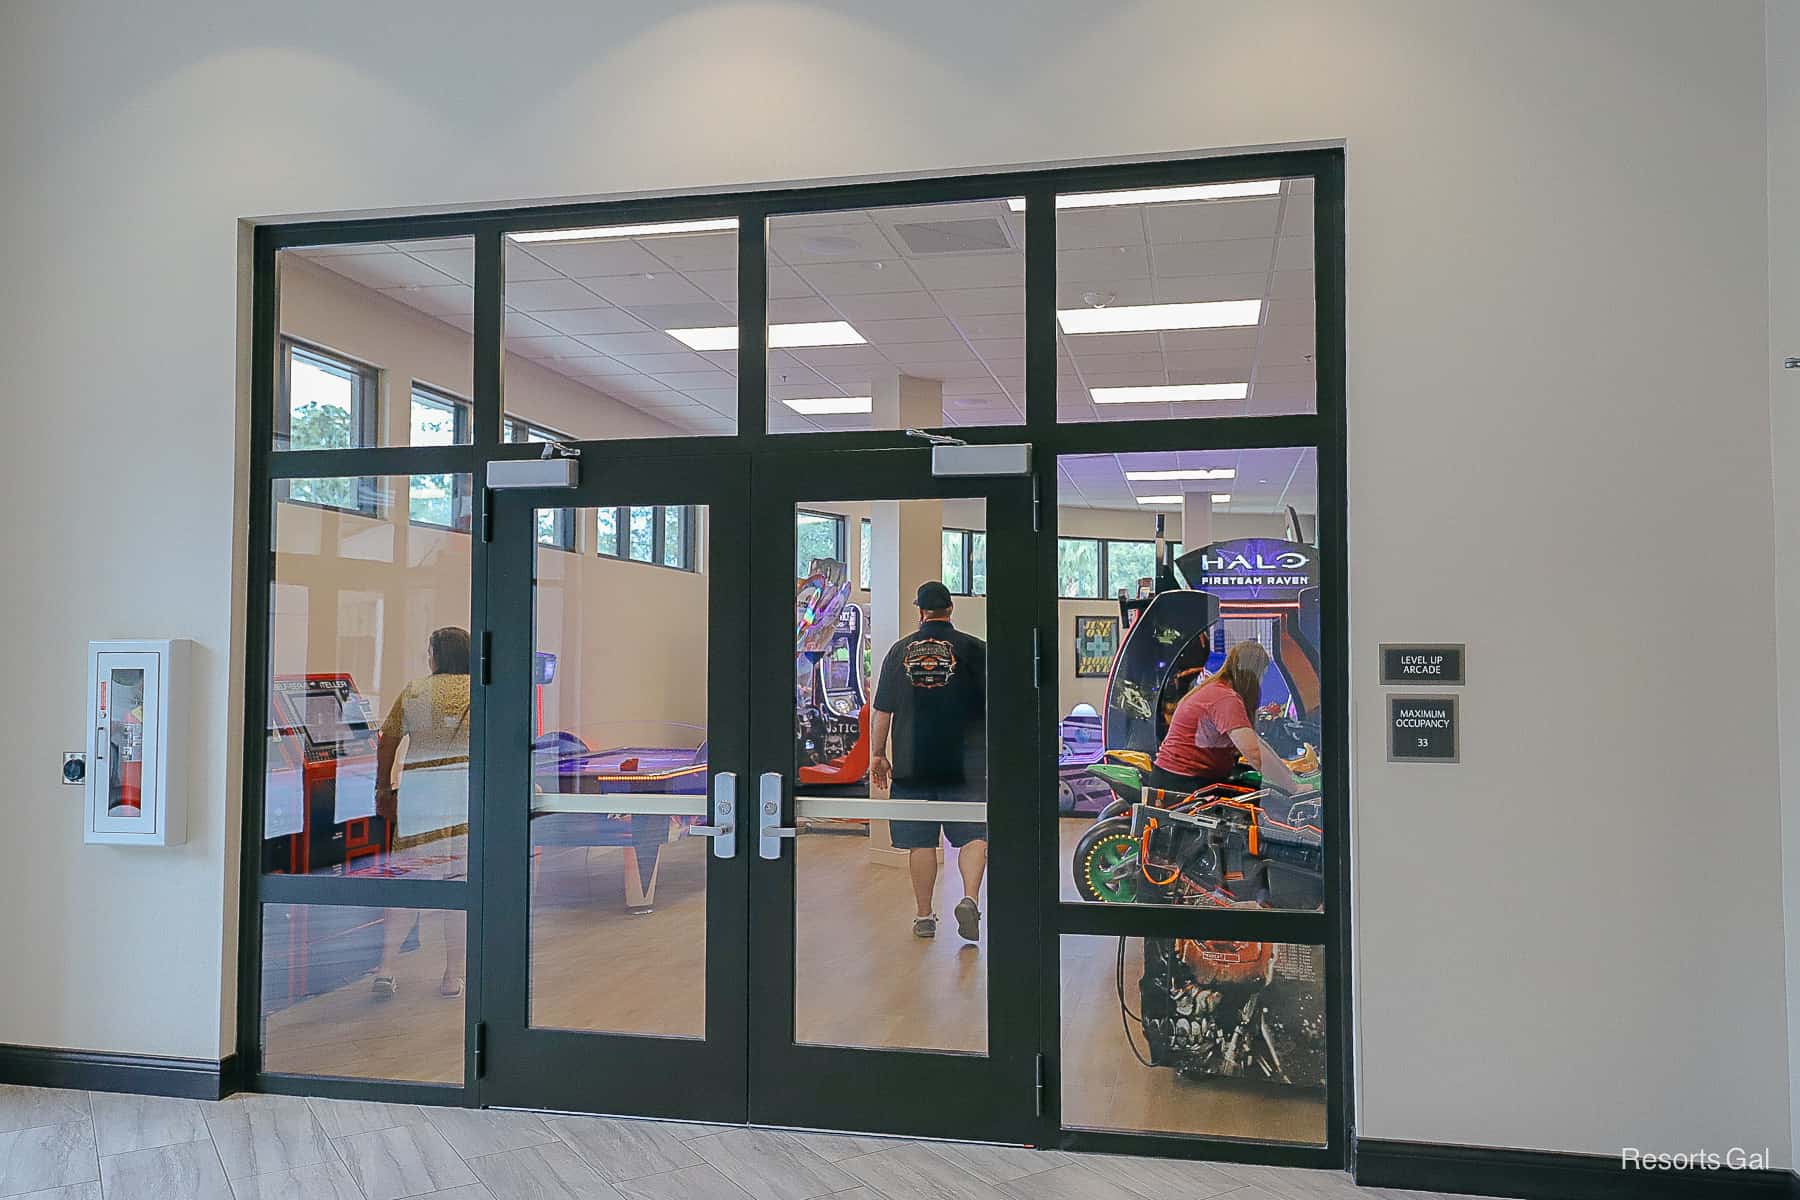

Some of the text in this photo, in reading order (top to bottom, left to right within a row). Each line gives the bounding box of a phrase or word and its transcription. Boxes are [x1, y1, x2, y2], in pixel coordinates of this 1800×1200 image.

[1202, 553, 1310, 570] HALO
[1202, 576, 1308, 585] FIRETEAM RAVEN
[1087, 629, 1111, 638] ONE
[1401, 656, 1443, 664] LEVEL UP
[1079, 665, 1110, 673] LEVE
[1403, 665, 1441, 674] ARCADE
[1400, 710, 1446, 719] MAXIMUM
[1395, 719, 1450, 729] OCCUPANCY
[1417, 738, 1429, 747] 33
